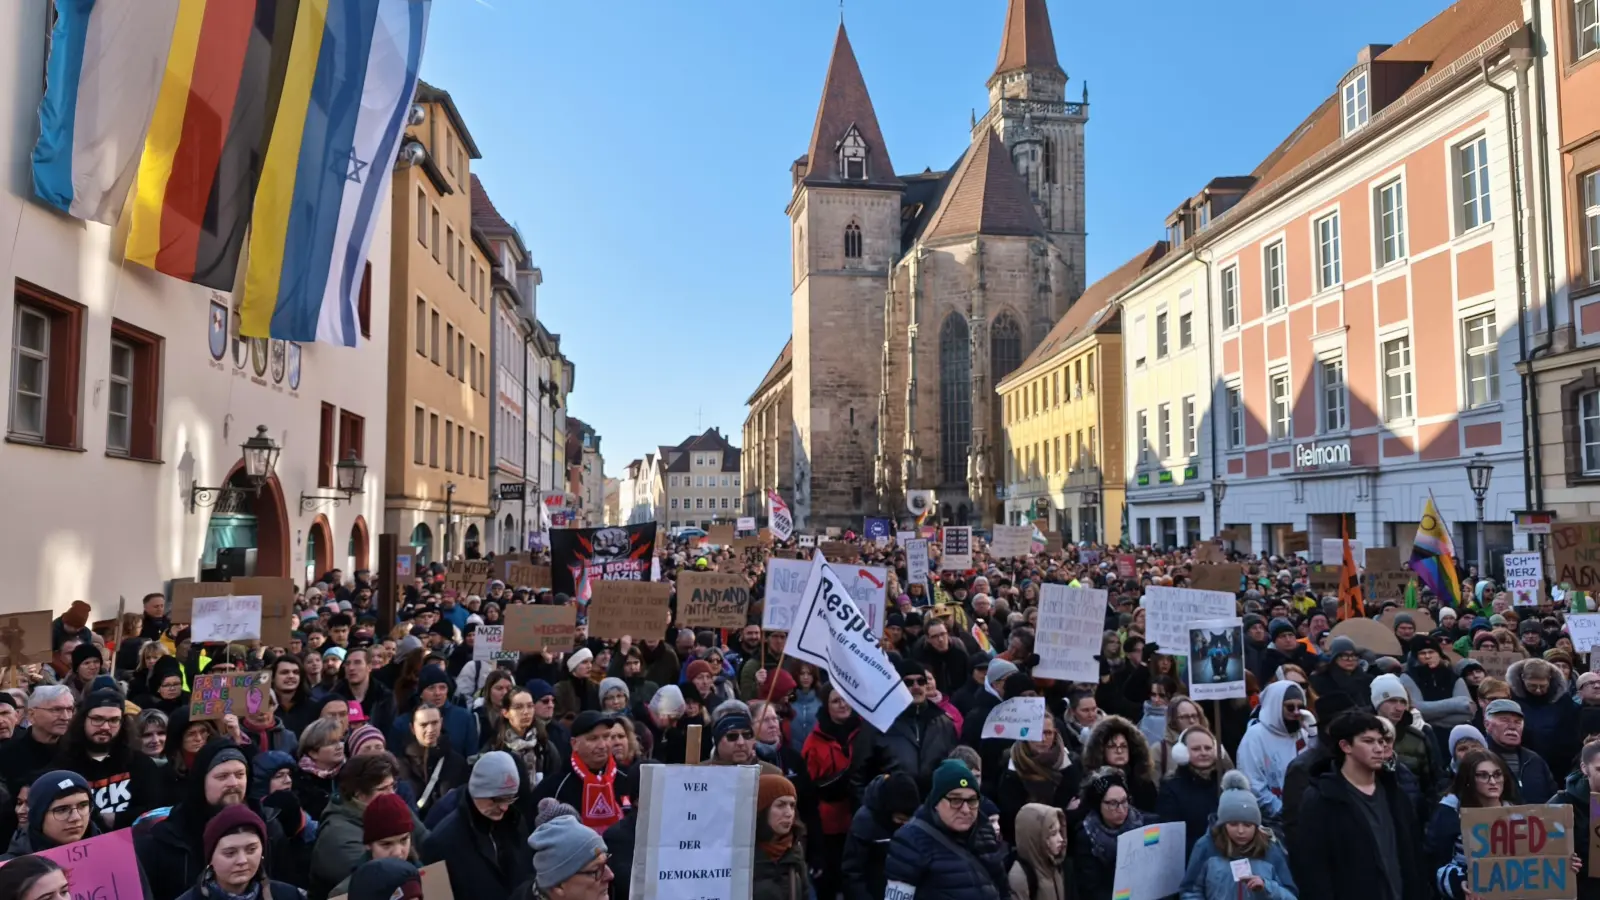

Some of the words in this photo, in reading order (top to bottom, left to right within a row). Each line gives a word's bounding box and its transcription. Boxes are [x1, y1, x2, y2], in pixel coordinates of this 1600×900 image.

[1507, 567, 1537, 577] MERZ
[683, 782, 708, 792] WER
[687, 811, 697, 821] In
[679, 840, 701, 850] DER
[66, 843, 92, 863] IST
[659, 868, 732, 881] DEMOKRATIE
[1472, 857, 1566, 893] LADEN
